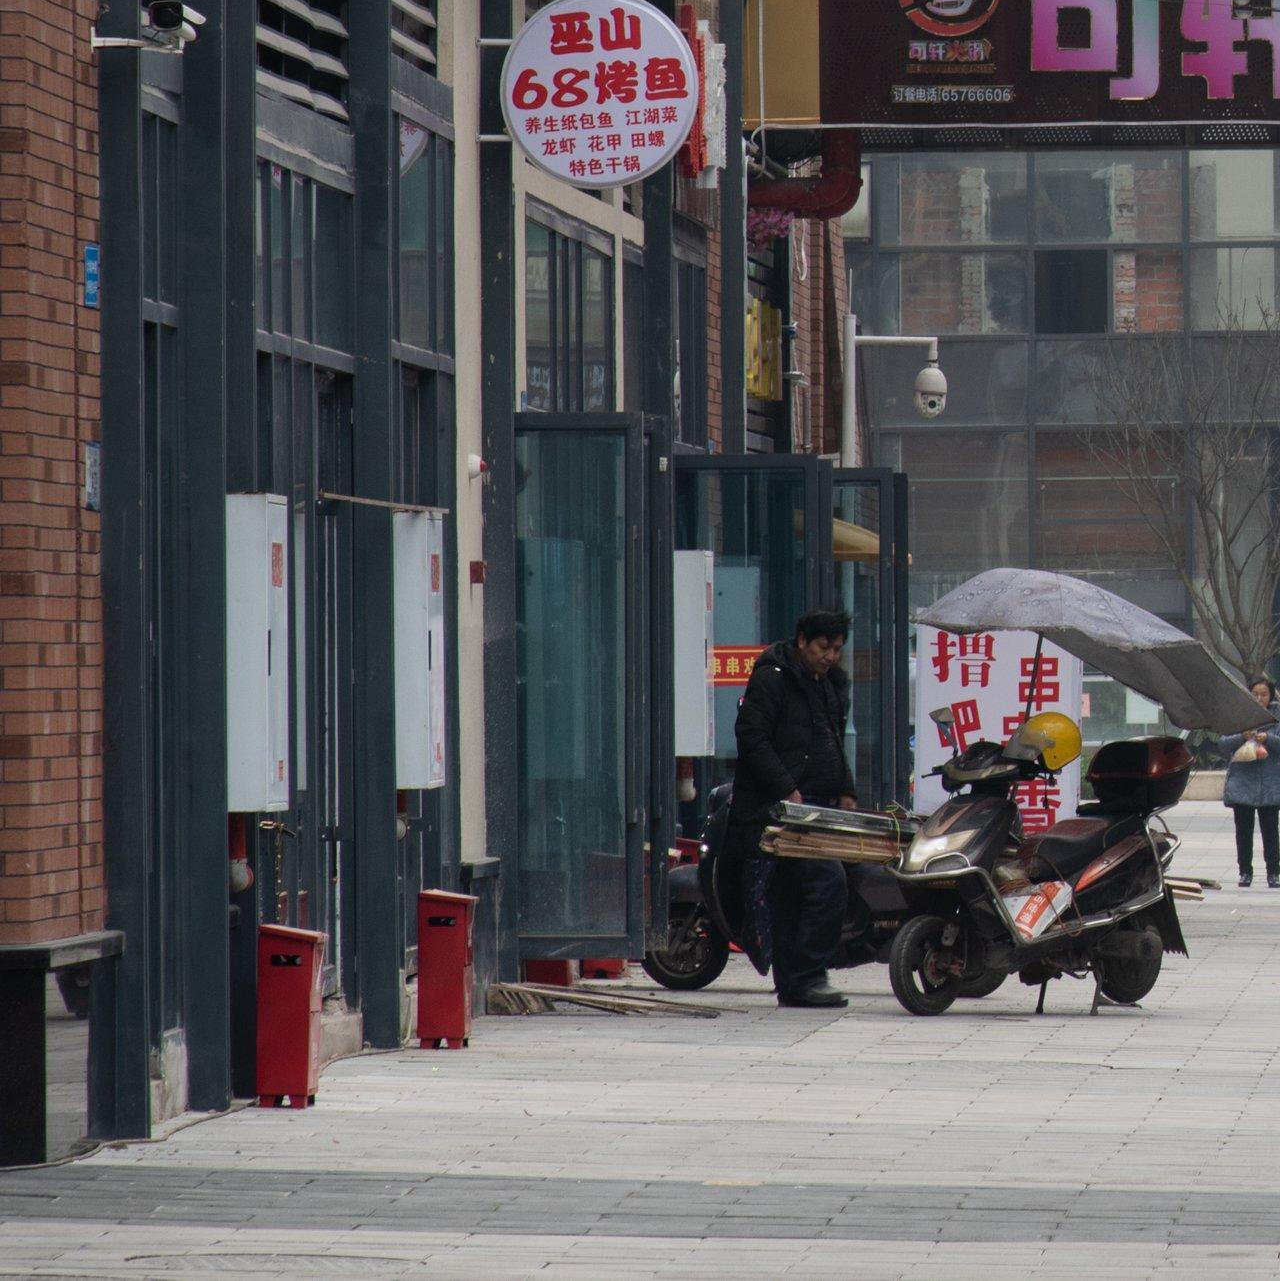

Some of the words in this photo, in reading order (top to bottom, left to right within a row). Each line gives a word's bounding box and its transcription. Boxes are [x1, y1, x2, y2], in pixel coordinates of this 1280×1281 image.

[550, 7, 641, 56] 巫山
[525, 110, 615, 134] 养生纸包鱼
[625, 106, 679, 125] 江湖菜
[541, 137, 577, 156] 龙虾
[588, 134, 622, 153] 花甲
[631, 130, 665, 148] 田螺
[569, 155, 641, 177] 特色干锅
